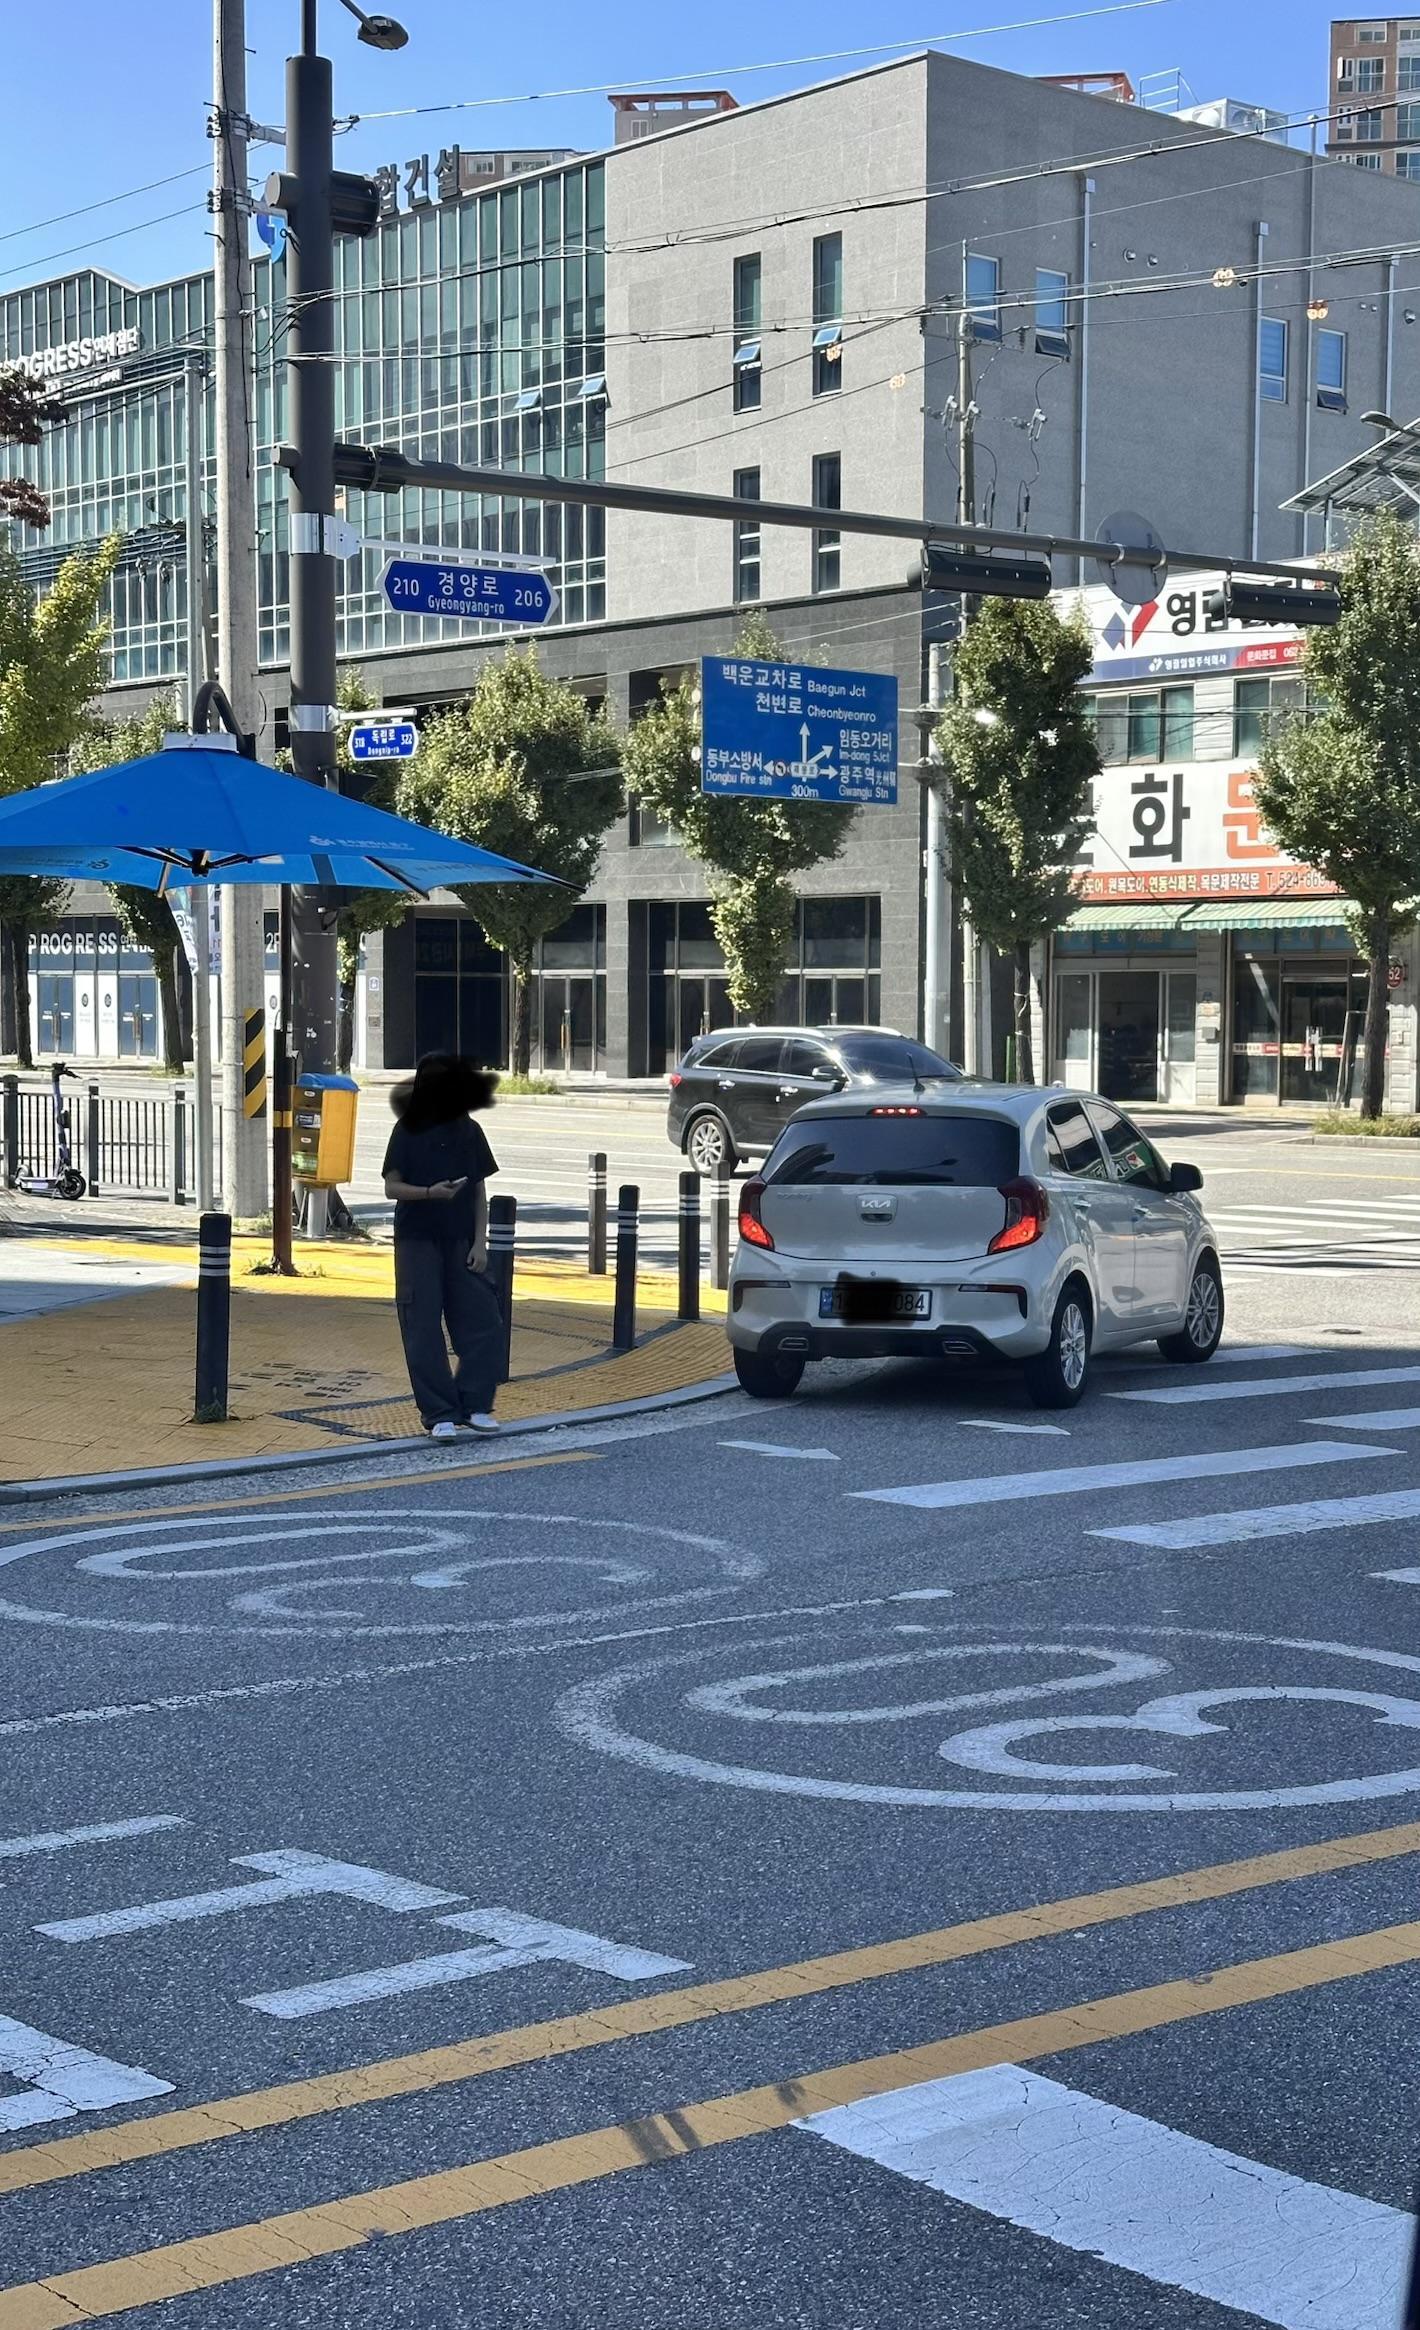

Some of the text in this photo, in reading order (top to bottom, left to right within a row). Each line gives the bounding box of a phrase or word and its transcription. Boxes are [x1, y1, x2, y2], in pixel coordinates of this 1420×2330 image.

[393, 577, 420, 596] 210
[438, 572, 500, 598] 경양로
[428, 594, 505, 616] Gyeongyang-ro
[514, 589, 543, 608] 206
[722, 664, 866, 698] 백운교차로 Baegun Jct
[756, 692, 877, 723] 천변로 Cheonbyeonro
[371, 729, 396, 745] 독립로
[839, 728, 892, 752] 임동오거리
[706, 748, 763, 772] 동부소방서
[705, 769, 738, 785] Dongbu
[740, 771, 756, 785] Fire
[839, 765, 875, 786] 광주역
[791, 783, 819, 798] 300m
